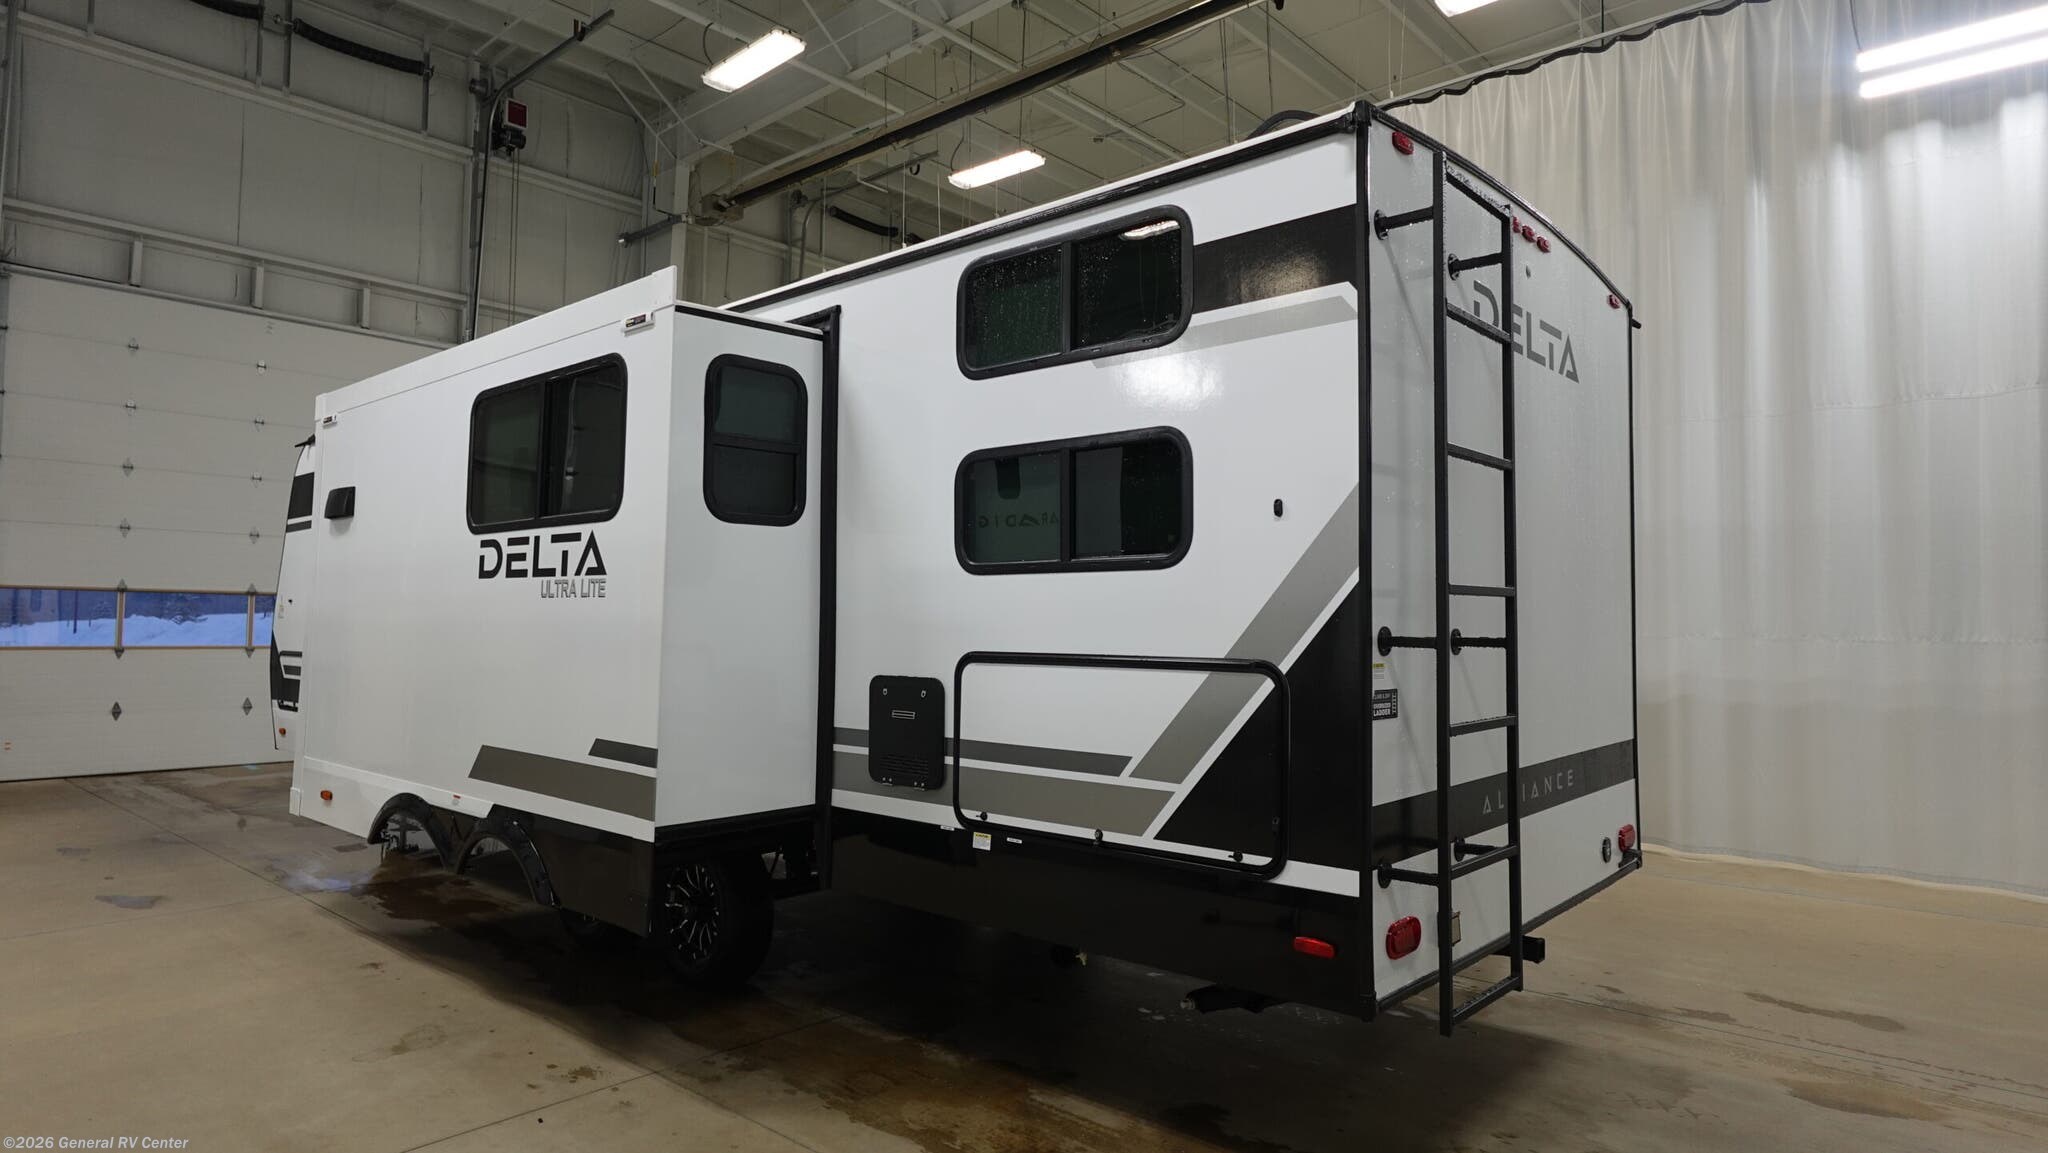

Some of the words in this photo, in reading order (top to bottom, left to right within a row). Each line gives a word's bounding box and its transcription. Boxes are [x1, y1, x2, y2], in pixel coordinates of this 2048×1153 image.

[1473, 280, 1580, 385] DELTA
[478, 530, 607, 579] DELTA
[540, 579, 577, 599] ULTRA
[580, 578, 607, 598] LITE
[1483, 769, 1575, 814] ALIANCE
